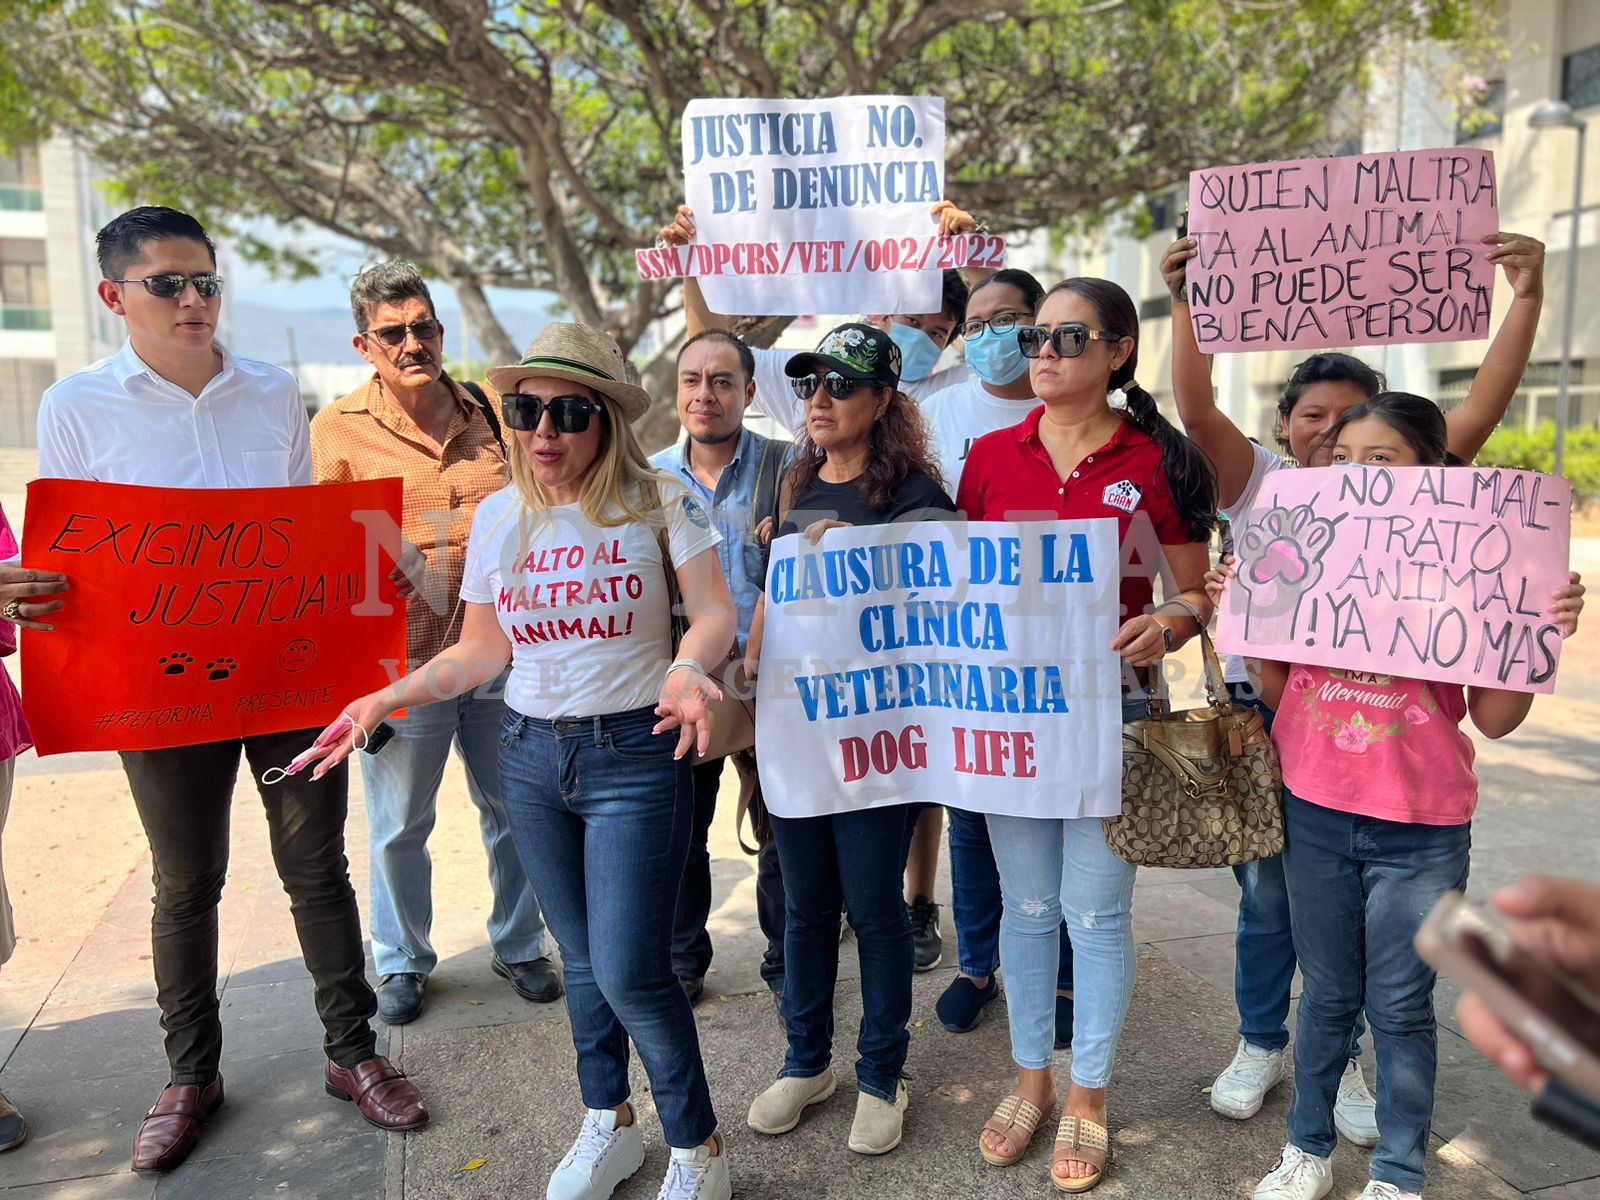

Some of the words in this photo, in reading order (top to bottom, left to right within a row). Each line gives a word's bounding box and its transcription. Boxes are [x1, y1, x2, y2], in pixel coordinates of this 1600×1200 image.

[690, 110, 838, 165] JUSTICIA
[866, 105, 924, 149] NO.
[709, 169, 758, 214] DE
[772, 160, 941, 210] DENUNCIA
[1200, 164, 1329, 214] QUIEN
[1353, 156, 1497, 208] MALTRA
[636, 234, 1005, 280] SSM/DPCRS/VET/002/2022
[1190, 228, 1237, 270] TA
[1251, 226, 1302, 266] AL
[1310, 208, 1482, 257] ANIMAL
[1191, 275, 1234, 307] NO
[1250, 258, 1367, 304] PUEDE
[1389, 248, 1488, 295] SER
[1192, 305, 1329, 343] BUENA
[1329, 283, 1491, 340] PERSONA
[1339, 466, 1395, 507] NO
[1410, 468, 1466, 508] AL
[49, 514, 293, 568] EXIGIMOS
[592, 540, 627, 565] AL
[770, 540, 952, 604] CLAUSURA
[968, 536, 1020, 586] DE
[1039, 533, 1094, 583] LA
[1354, 515, 1512, 574] TRATO
[130, 573, 360, 627] JUSTICIA!!!
[498, 573, 642, 612] MALTRATO
[1336, 555, 1541, 617] ANIMAL
[511, 611, 633, 644] ANIMAL!
[859, 592, 1008, 652] CLÍNICA
[1388, 606, 1467, 668] NO
[1474, 617, 1561, 684] MAS
[92, 703, 214, 730] #REFORMA
[234, 685, 337, 718] PRESENTE
[794, 661, 1069, 721] VETERINARIA
[1315, 680, 1408, 710] Mermaid
[1367, 675, 1378, 684] A
[839, 724, 928, 783] DOG
[951, 726, 1037, 778] LIFE
